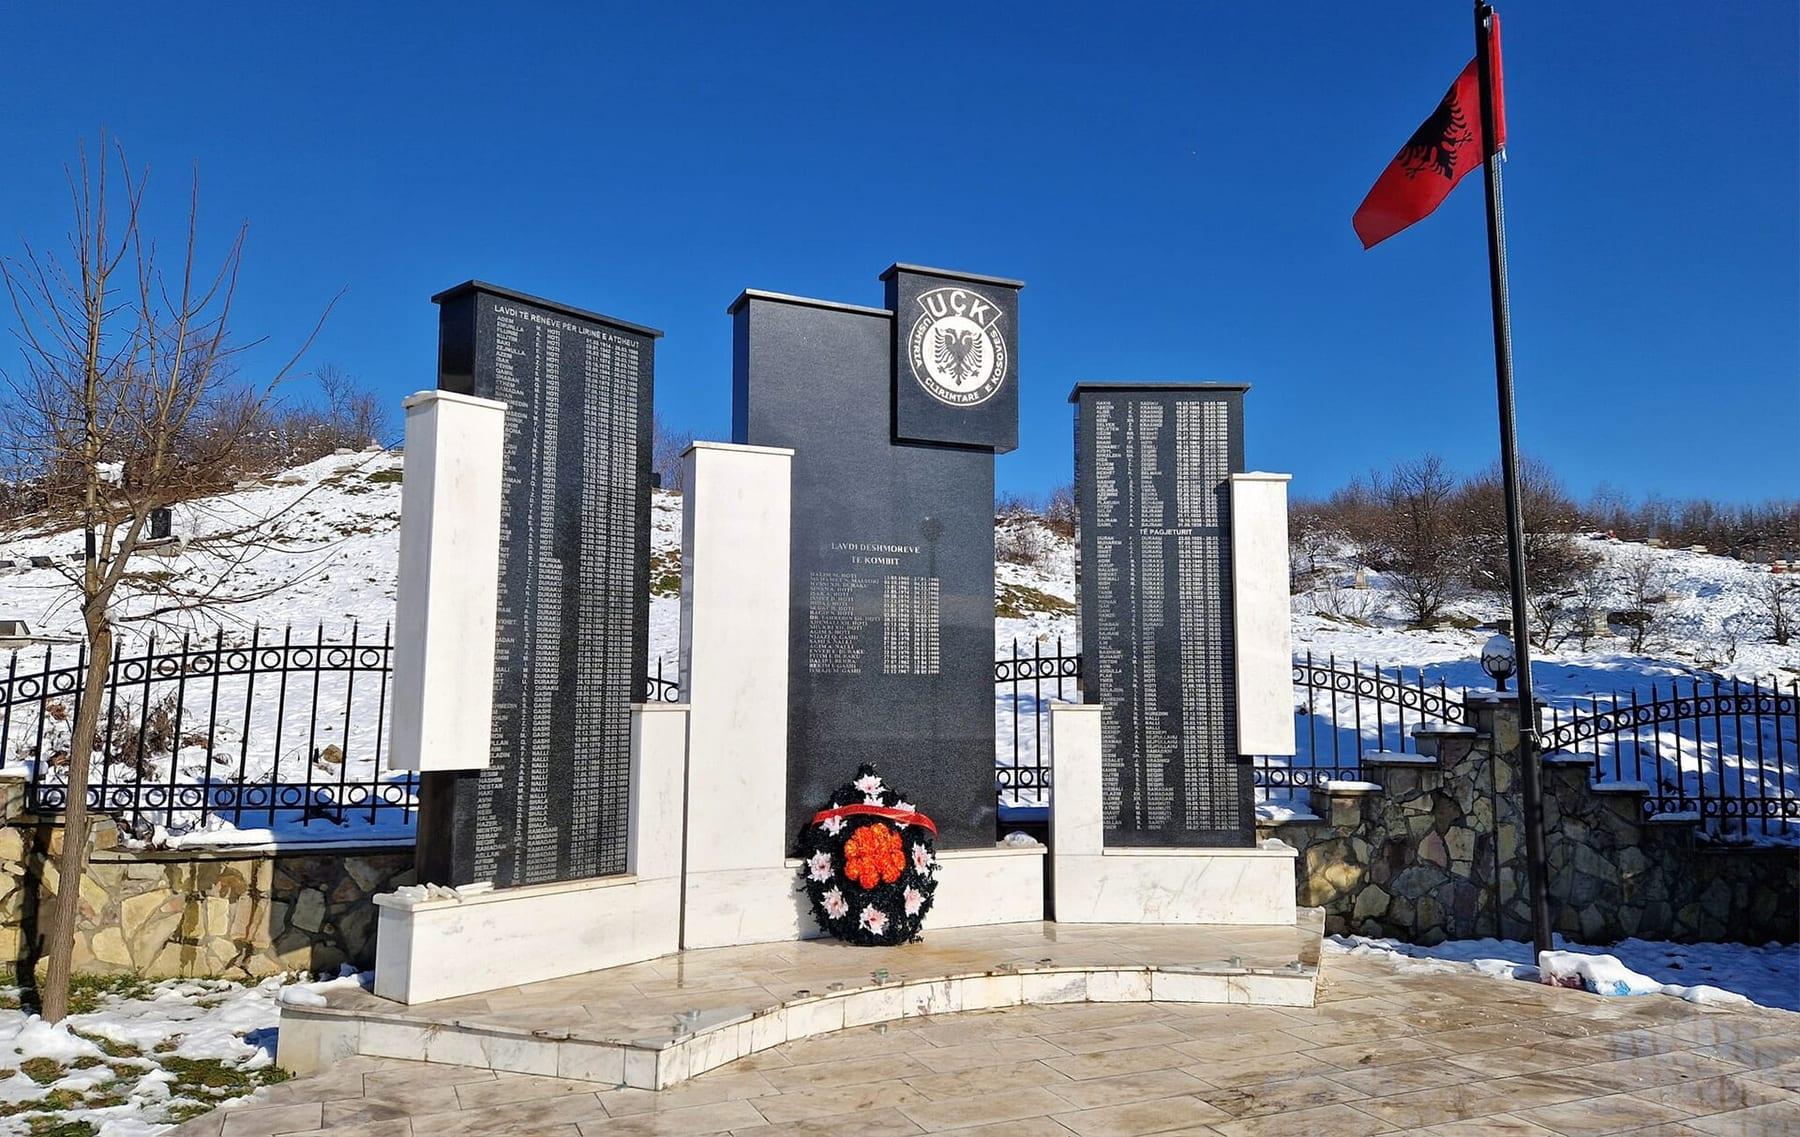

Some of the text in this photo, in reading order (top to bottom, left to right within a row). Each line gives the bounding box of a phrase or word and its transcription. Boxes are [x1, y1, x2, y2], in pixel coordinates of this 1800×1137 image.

[494, 304, 517, 317] LAVDI
[926, 291, 990, 325] UÇK
[914, 317, 932, 367] USHTRIA
[985, 384, 993, 392] E
[832, 542, 857, 550] LAVDI
[865, 557, 900, 565] KOMBIT
